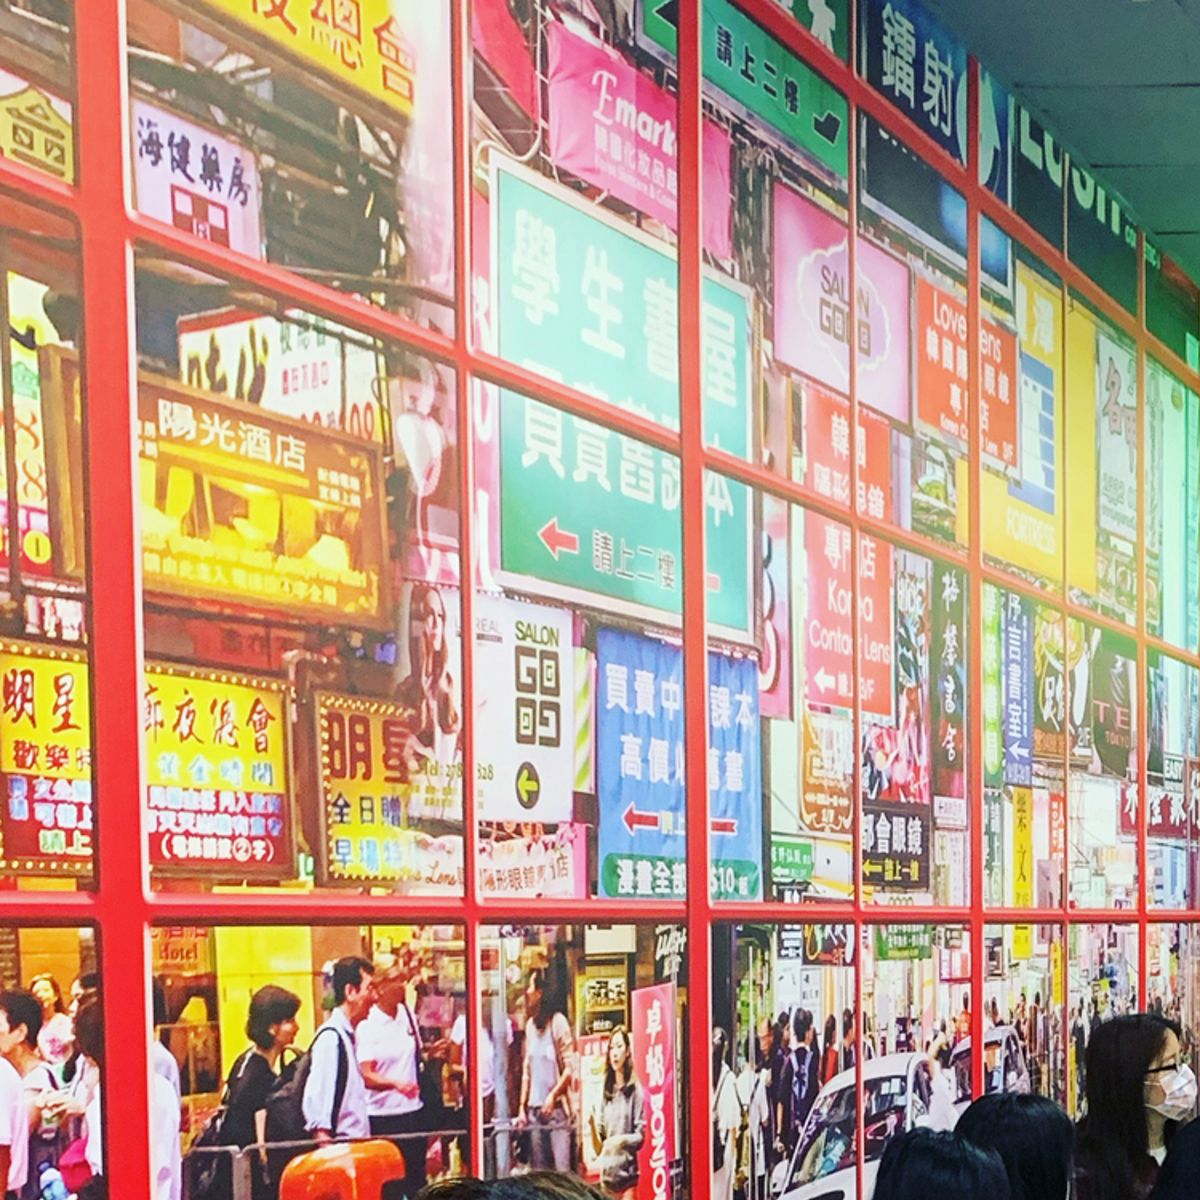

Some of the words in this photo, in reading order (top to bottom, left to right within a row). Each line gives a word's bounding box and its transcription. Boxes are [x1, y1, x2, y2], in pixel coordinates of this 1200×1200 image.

[821, 263, 869, 318] SALN
[820, 297, 871, 357] GOO
[158, 399, 306, 471] 陽光酒店
[592, 529, 676, 590] 請上二樓
[828, 579, 873, 623] Kora
[515, 620, 559, 647] SALON
[809, 620, 862, 660] Conta
[3, 669, 82, 733] 明星
[606, 663, 755, 730] 買賣中課本
